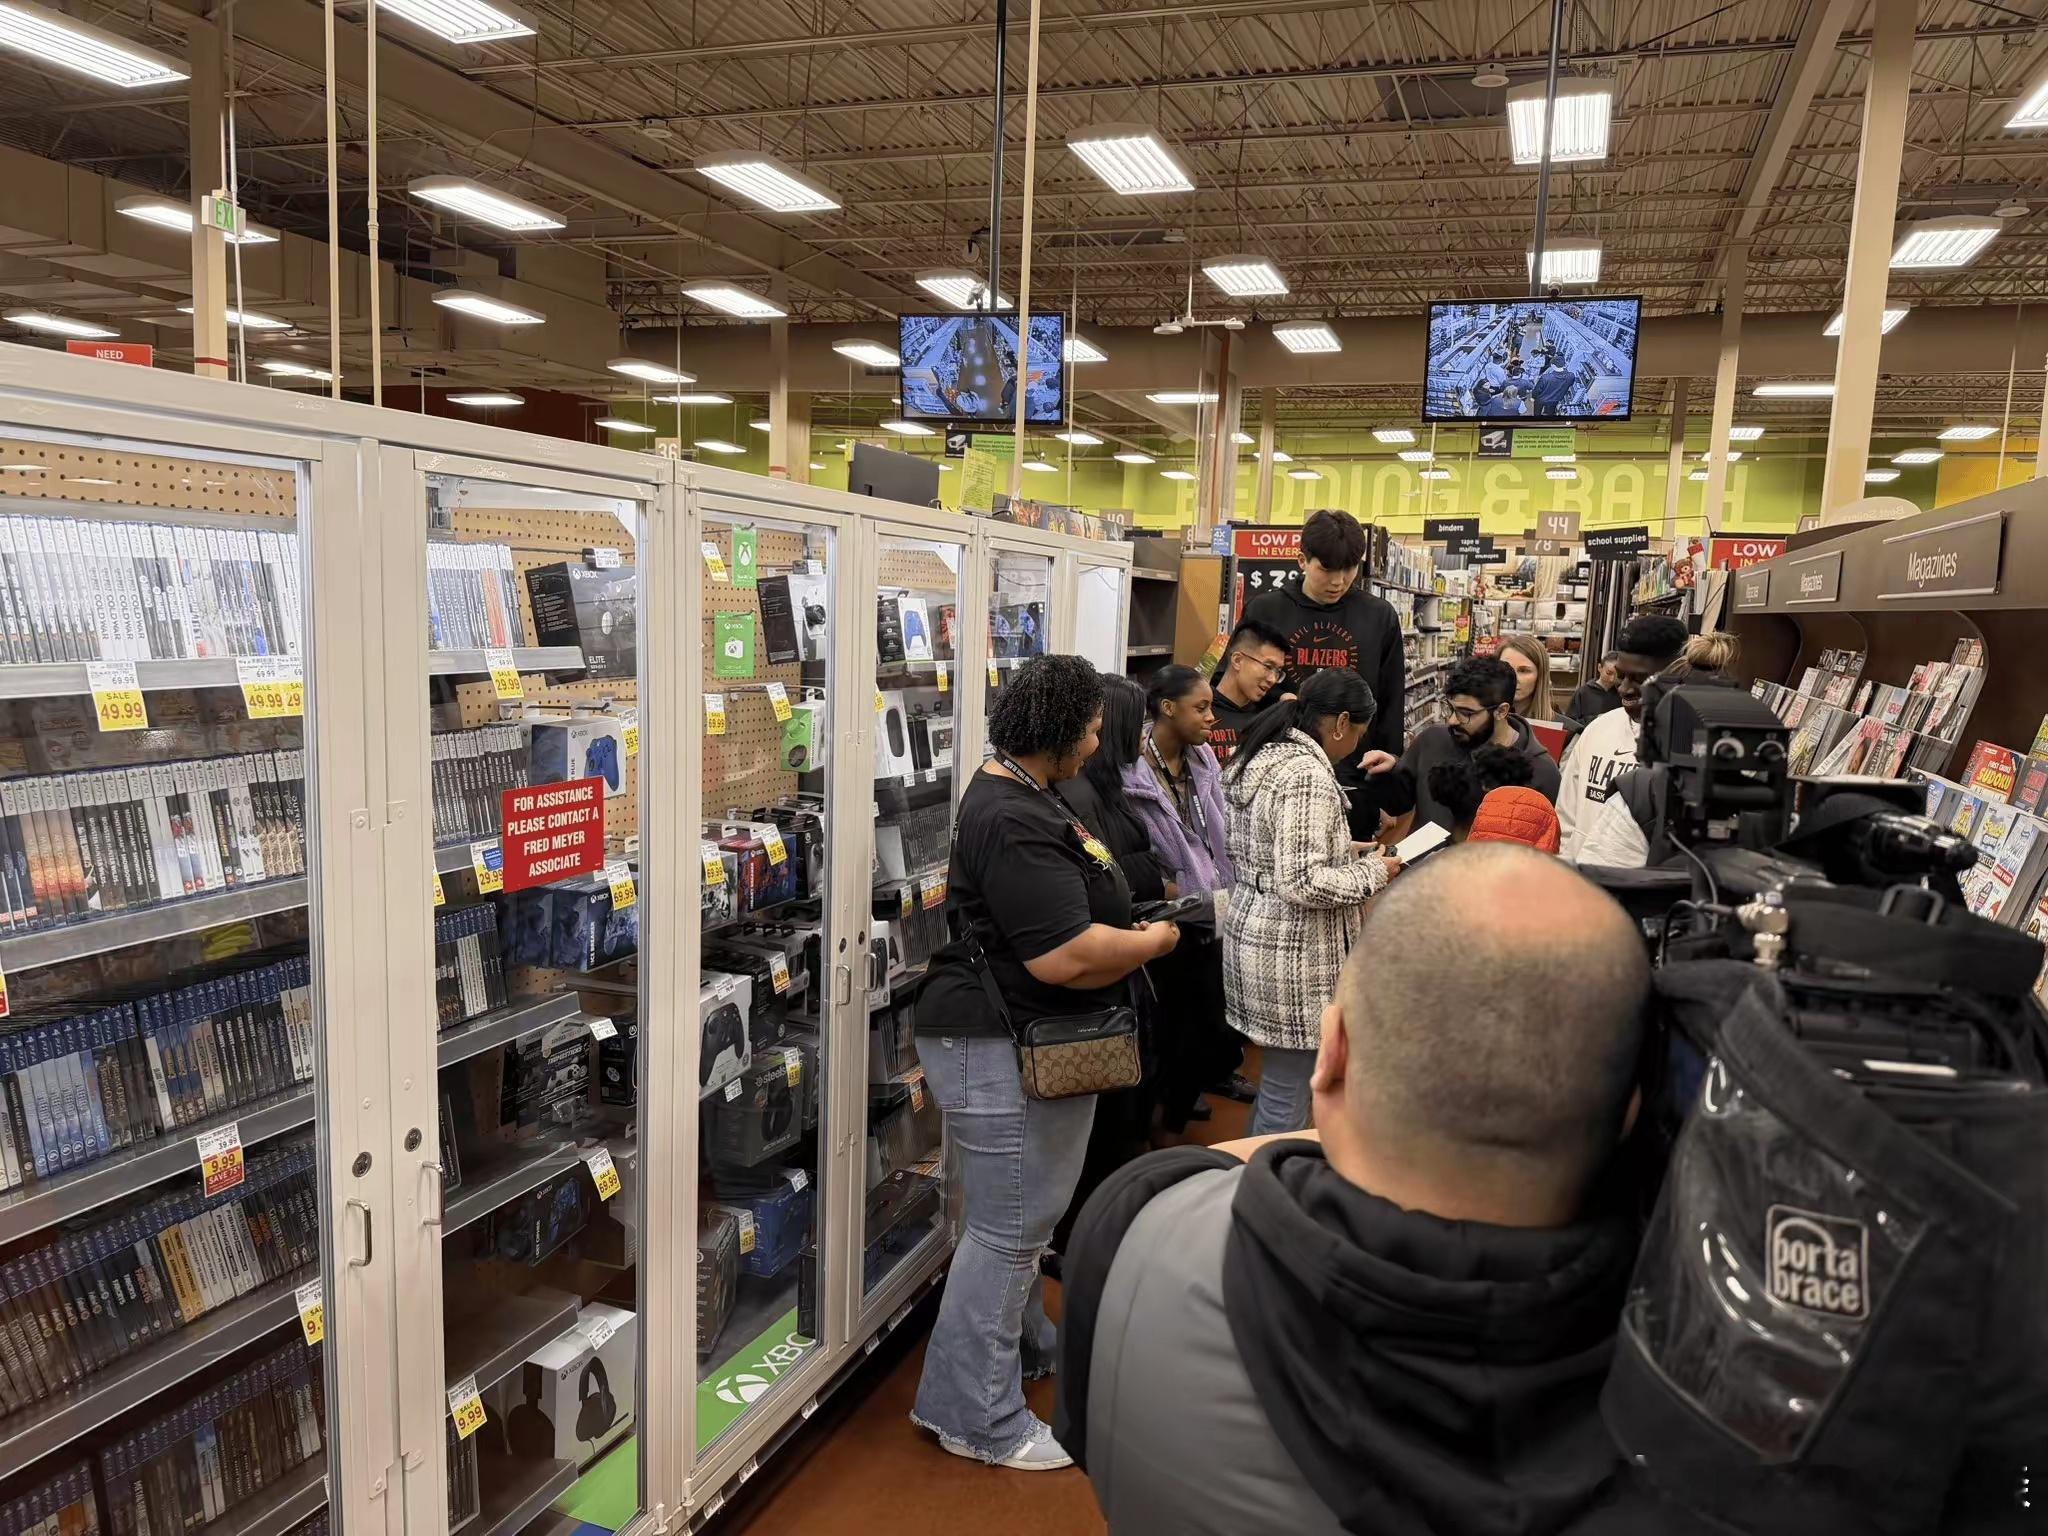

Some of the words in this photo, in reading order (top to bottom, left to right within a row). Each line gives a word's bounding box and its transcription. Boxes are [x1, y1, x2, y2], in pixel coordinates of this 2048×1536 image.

[216, 199, 243, 232] EX
[96, 350, 124, 360] NEED
[1438, 524, 1464, 533] binders
[1548, 517, 1569, 535] 44
[1252, 533, 1288, 546] LOW
[1587, 534, 1613, 546] school
[1614, 533, 1647, 546] supplies
[1257, 547, 1269, 556] IN
[1459, 546, 1481, 554] mailing
[1733, 543, 1778, 557] LOW
[1740, 558, 1753, 567] IN
[1907, 547, 1958, 589] Magazines
[580, 569, 599, 580] XBOX
[94, 593, 105, 618] COLD
[106, 594, 118, 620] COLD
[118, 594, 130, 621] COLD
[130, 594, 142, 620] COLD
[98, 617, 109, 641] WAR
[110, 618, 122, 641] WAR
[123, 620, 134, 641] WAR
[134, 619, 145, 640] WAR
[588, 655, 606, 665] ELITE
[1296, 647, 1348, 667] BLAZERS
[495, 679, 520, 691] 29.99
[106, 692, 130, 700] SALE
[249, 693, 283, 708] 49.99
[287, 693, 301, 707] 29
[100, 703, 143, 720] 49.99
[1588, 754, 1641, 786] BLAZE
[1977, 767, 2013, 791] SUDOKU
[513, 796, 535, 813] FOR
[536, 786, 594, 810] ASSISTANCE
[290, 795, 305, 845] OUTRIDERS
[507, 818, 545, 837] PLEASE
[547, 809, 591, 830] CONTACT
[591, 806, 600, 821] A
[523, 838, 550, 857] FRED
[551, 830, 586, 850] MEYER
[528, 852, 581, 878] ASSOCIATE
[613, 887, 635, 904] 69.99
[763, 1064, 787, 1083] steels
[211, 1153, 236, 1173] 9.99
[208, 1170, 228, 1185] SAVE
[599, 1175, 619, 1193] 69.99
[216, 1213, 230, 1247] FISHING
[226, 1209, 239, 1242] FISHING
[1773, 1217, 1859, 1279] porta
[1773, 1269, 1861, 1312] brace
[310, 1305, 322, 1317] SAL
[751, 1331, 817, 1376] XBO
[459, 1401, 476, 1414] SALE
[457, 1405, 483, 1431] 9.99
